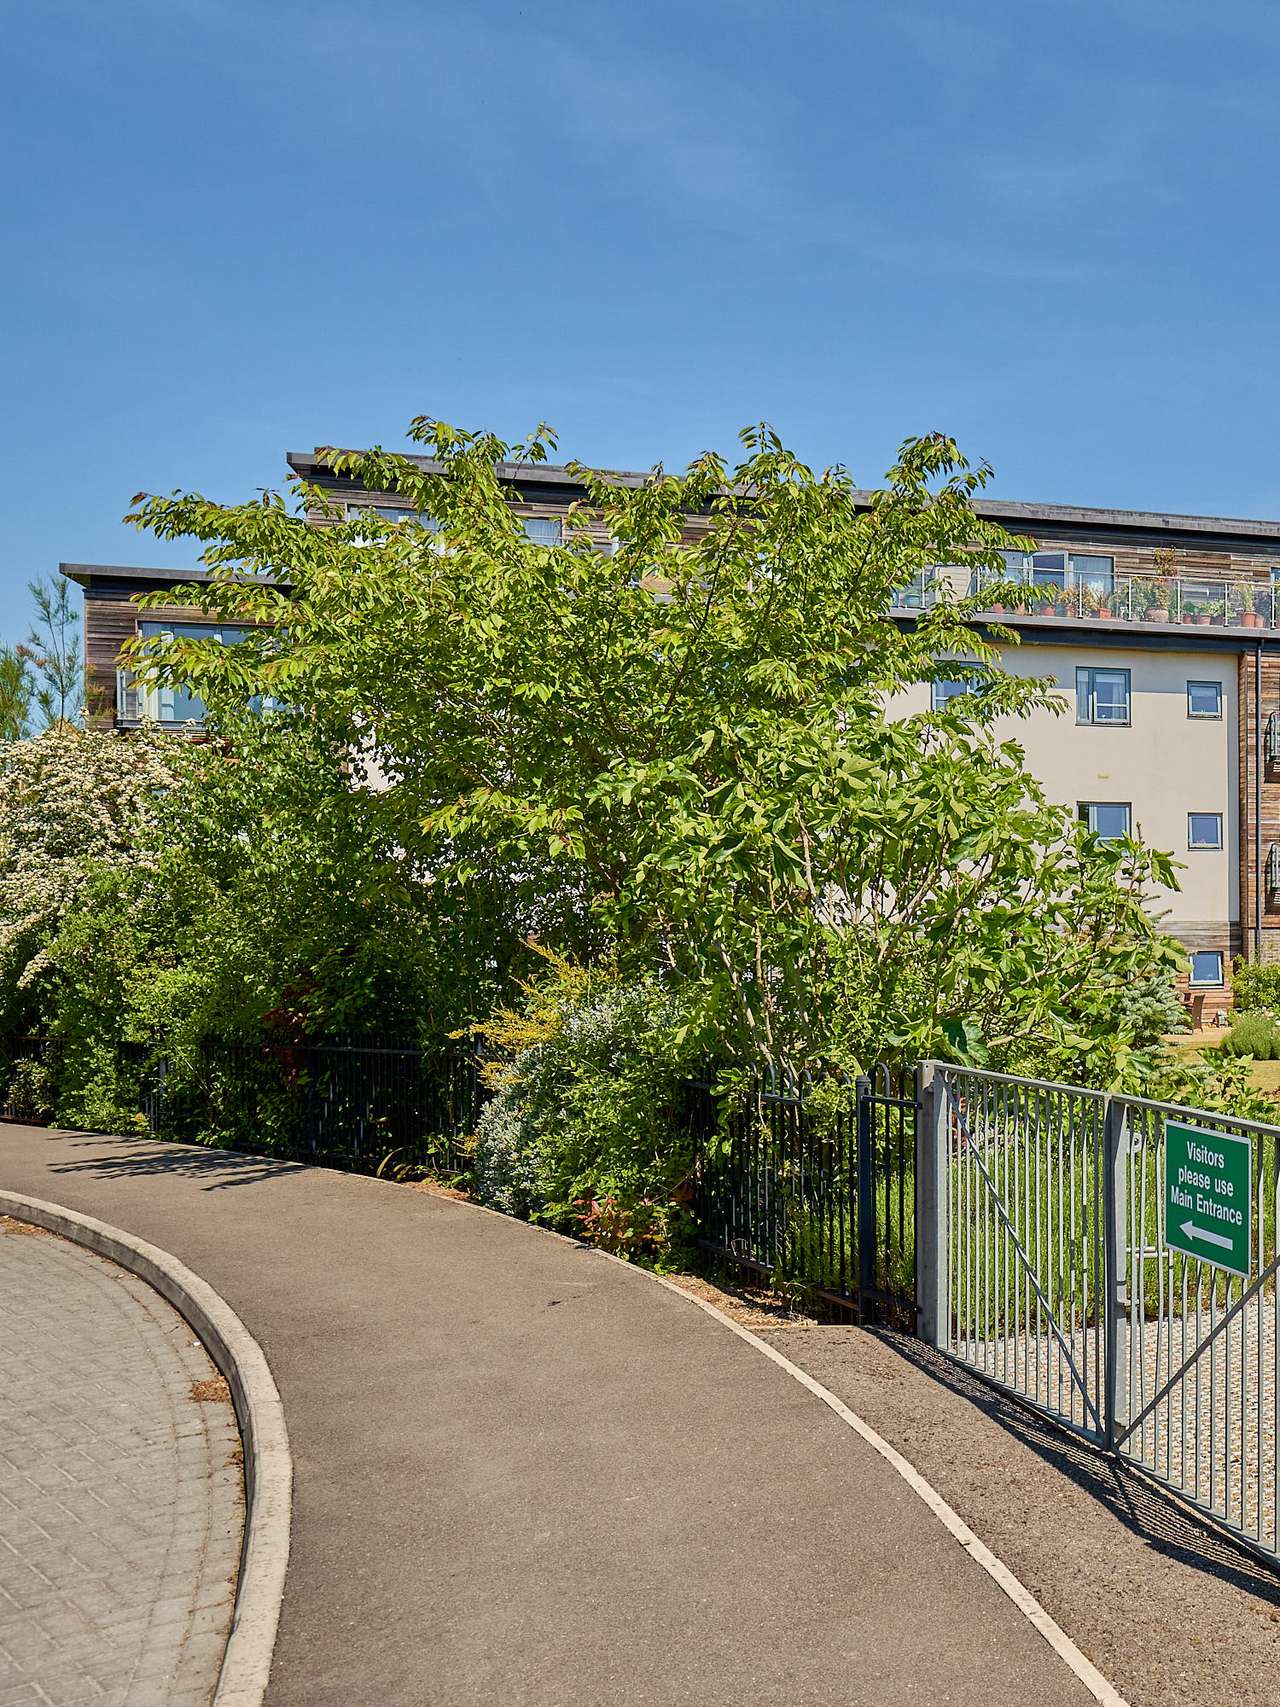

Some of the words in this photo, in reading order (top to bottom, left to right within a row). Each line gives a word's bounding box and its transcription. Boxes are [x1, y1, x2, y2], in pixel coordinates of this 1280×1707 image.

[1187, 1141, 1224, 1168] Visitors
[1178, 1165, 1210, 1189] please
[1214, 1177, 1234, 1197] use
[1170, 1185, 1193, 1209] Main
[1196, 1194, 1242, 1225] Entrance
